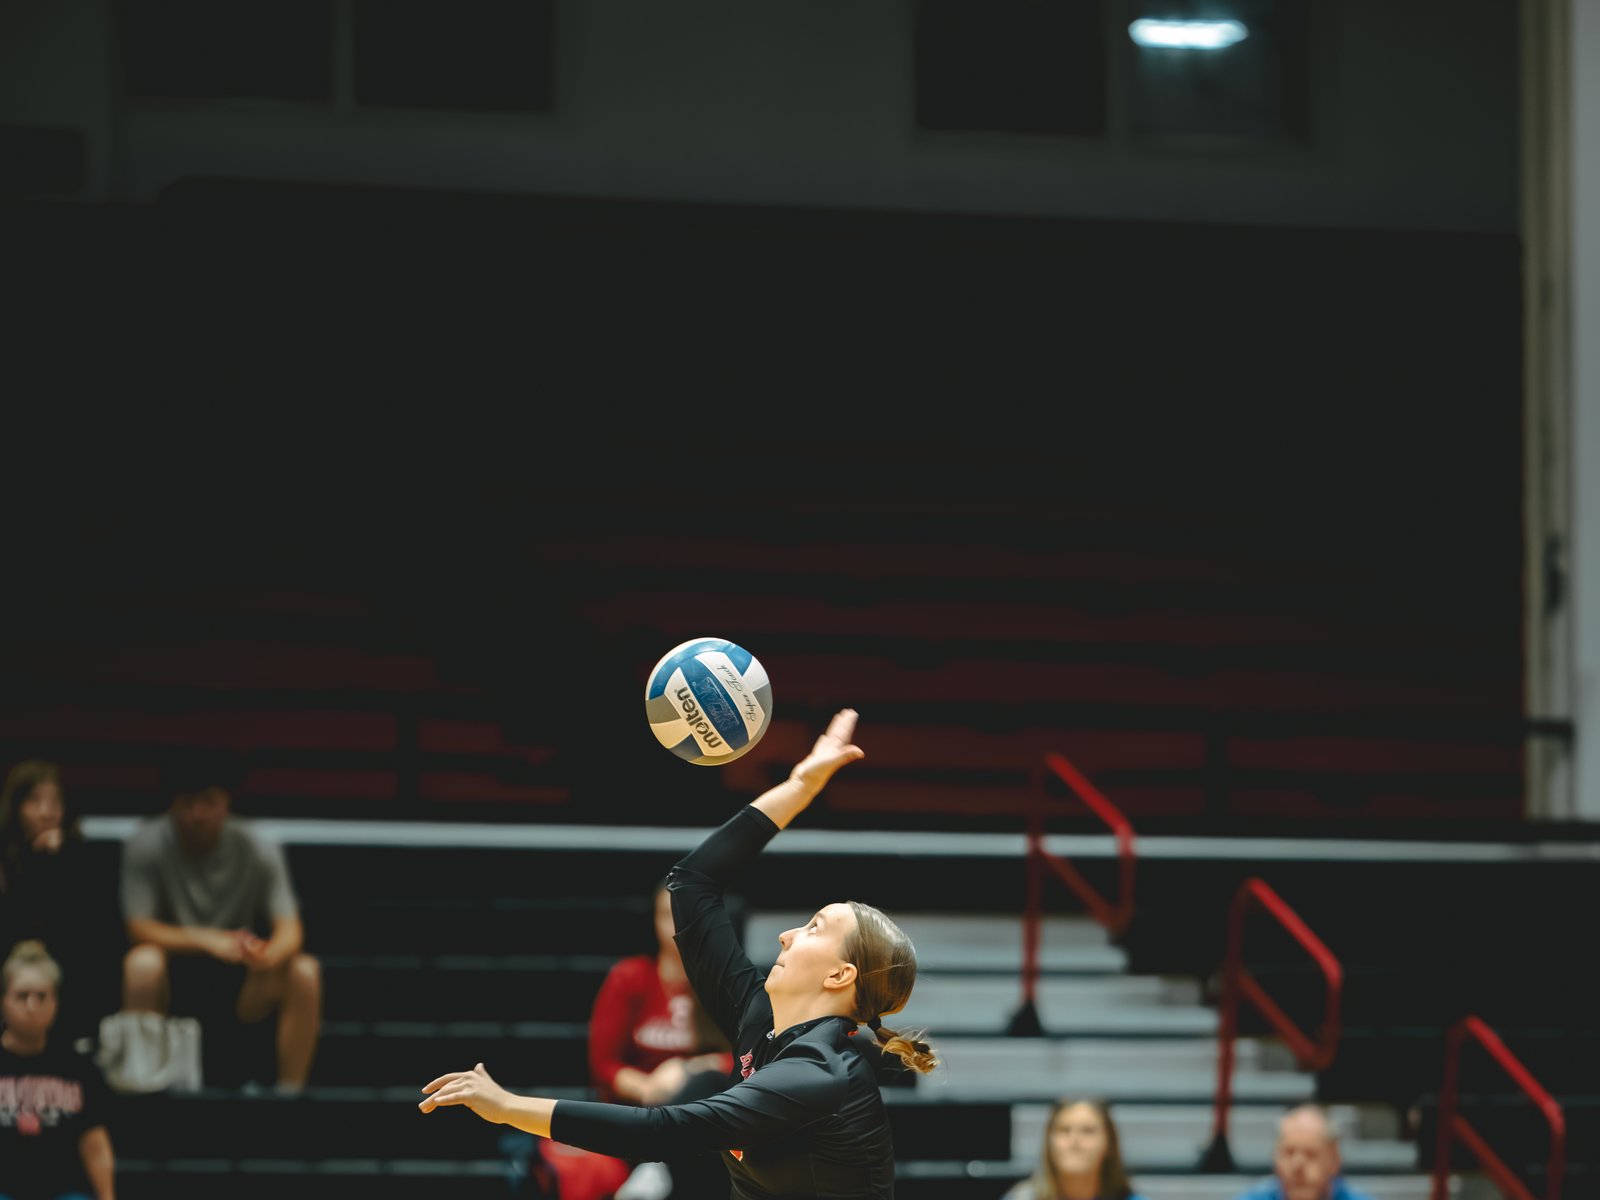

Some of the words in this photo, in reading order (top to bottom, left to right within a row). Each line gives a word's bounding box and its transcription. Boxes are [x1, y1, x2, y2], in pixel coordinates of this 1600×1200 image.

[716, 664, 743, 692] Touch
[676, 686, 722, 749] molten
[743, 694, 756, 722] Super
